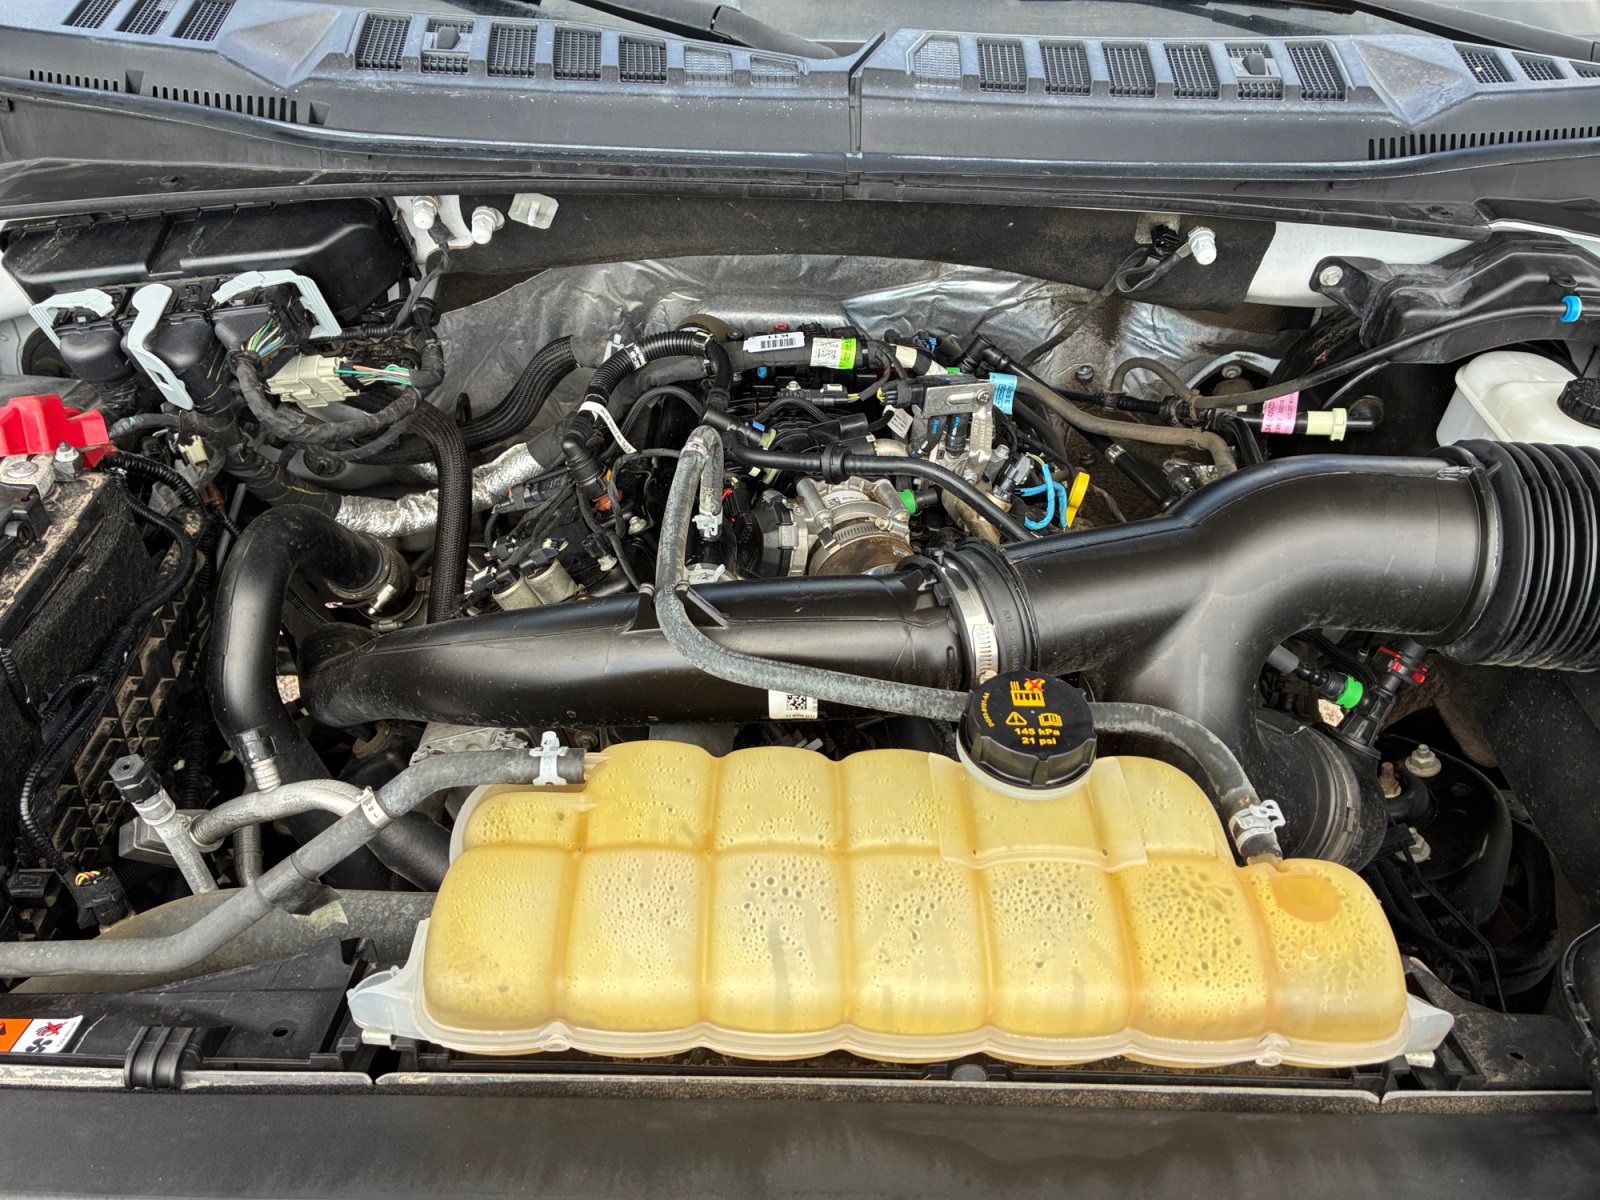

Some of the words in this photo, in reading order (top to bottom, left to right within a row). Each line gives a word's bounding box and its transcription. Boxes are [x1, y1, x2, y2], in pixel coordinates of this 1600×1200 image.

[1014, 728, 1036, 736] 145
[1038, 728, 1060, 736] kPa
[1039, 737, 1057, 746] psi
